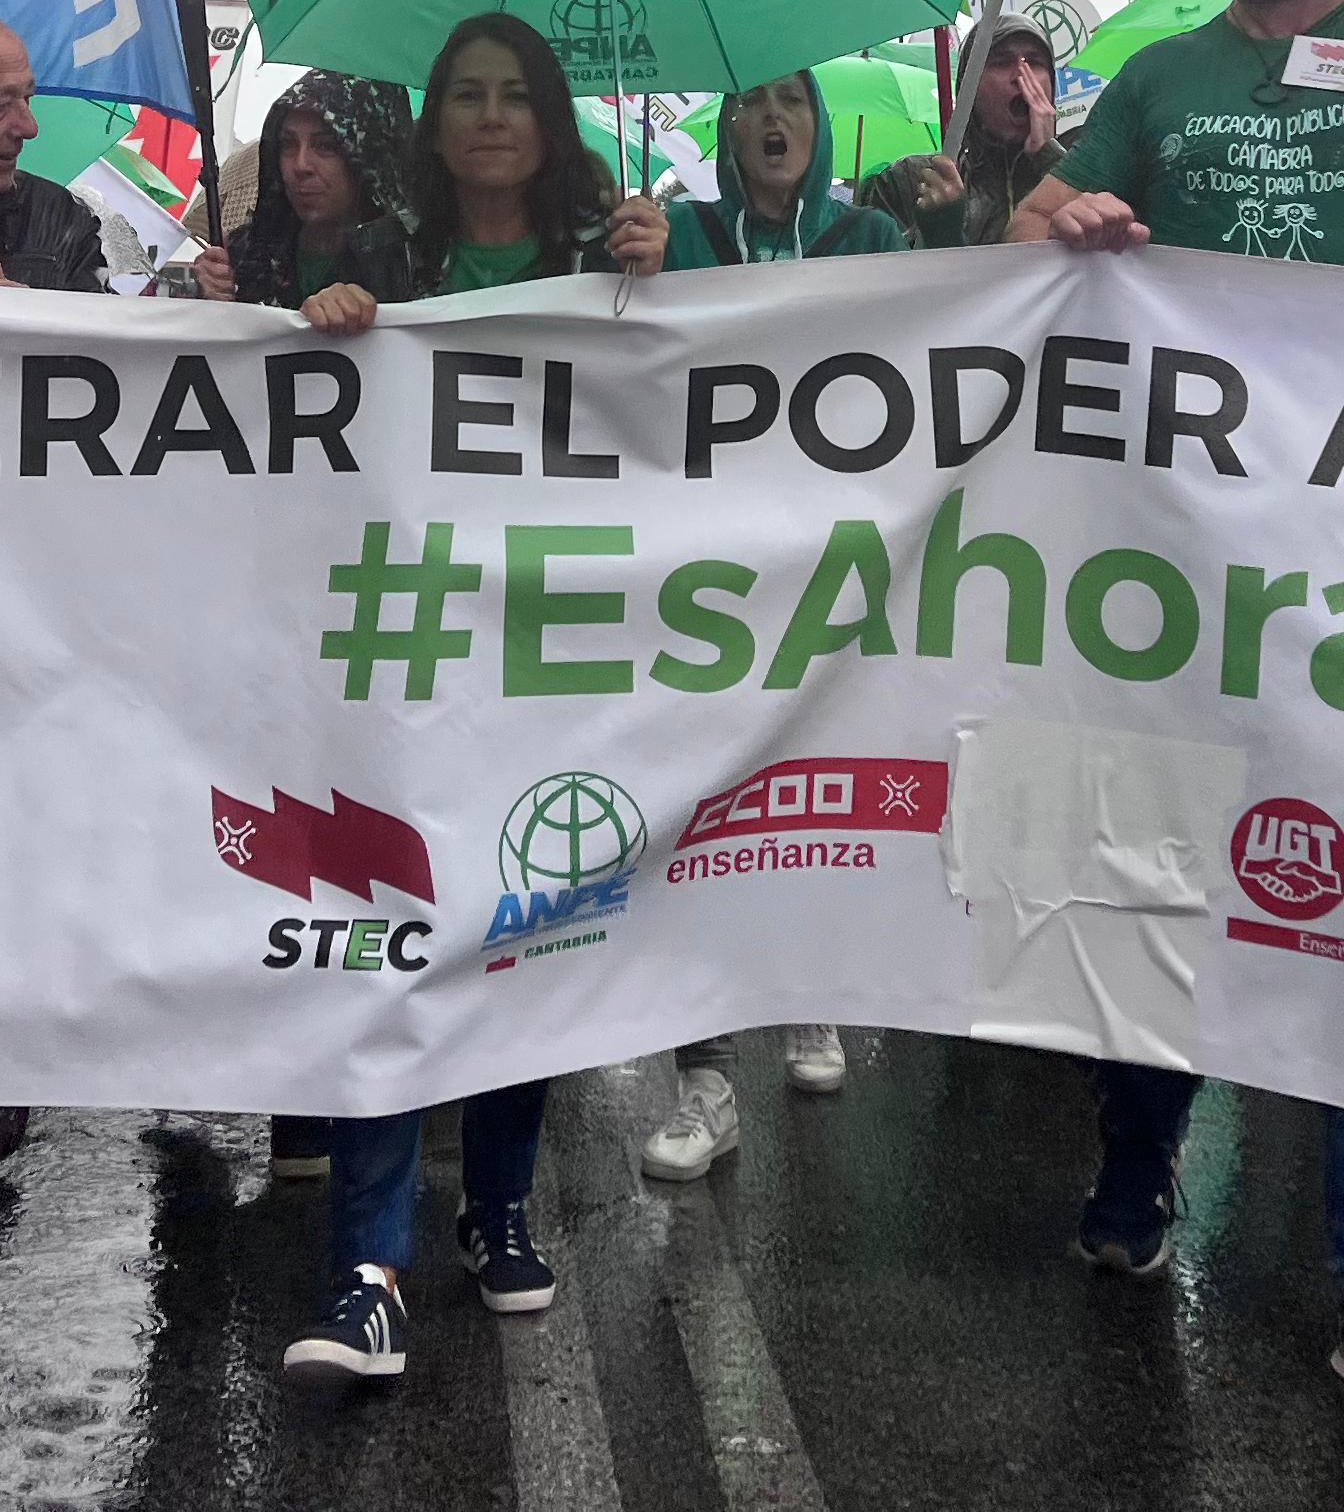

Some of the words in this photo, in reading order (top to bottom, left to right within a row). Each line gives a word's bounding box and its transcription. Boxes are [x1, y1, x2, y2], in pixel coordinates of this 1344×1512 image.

[1186, 171, 1205, 191] DE
[1265, 177, 1304, 199] PARA
[431, 349, 621, 479] EL
[684, 334, 1250, 479] PODER
[690, 771, 854, 837] CCOO
[666, 837, 877, 885] enseñanza
[1243, 813, 1338, 875] UGT
[260, 918, 434, 973] STEC
